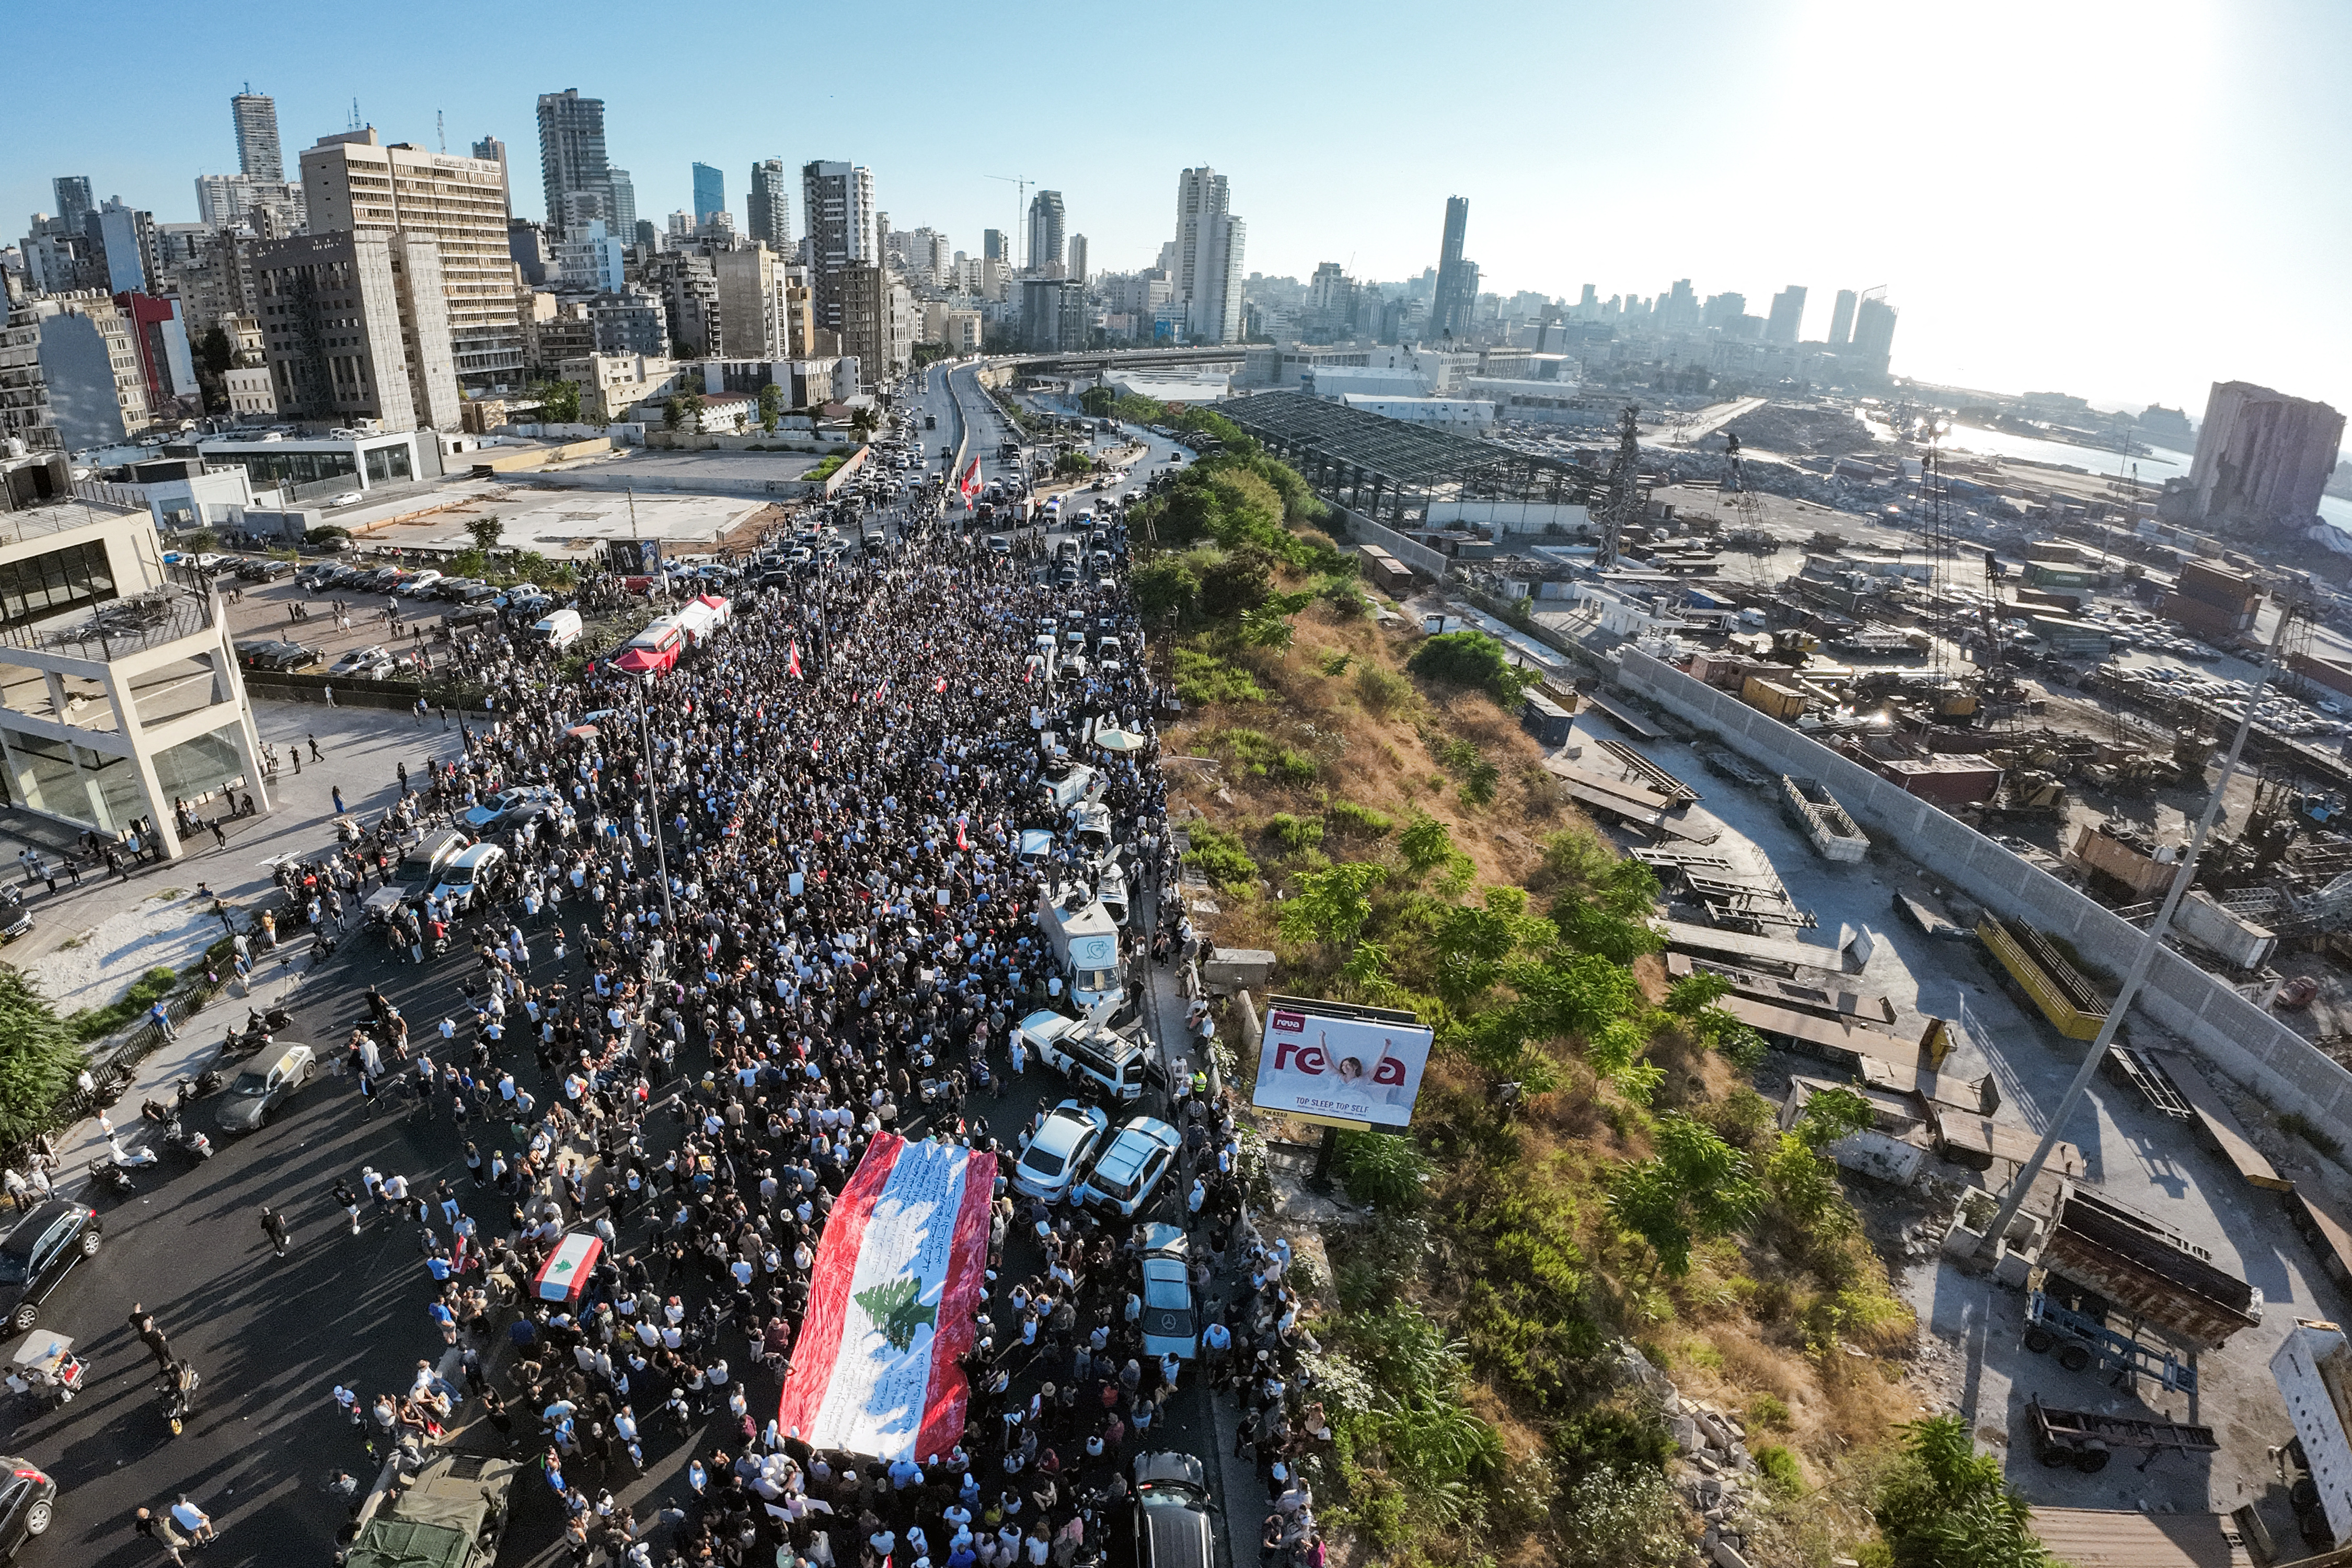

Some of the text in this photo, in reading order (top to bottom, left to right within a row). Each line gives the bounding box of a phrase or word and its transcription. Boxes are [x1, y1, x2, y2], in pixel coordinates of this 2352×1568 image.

[1276, 1019, 1300, 1028] reva
[1274, 1043, 1406, 1087] rea
[1296, 1097, 1309, 1105] TOP
